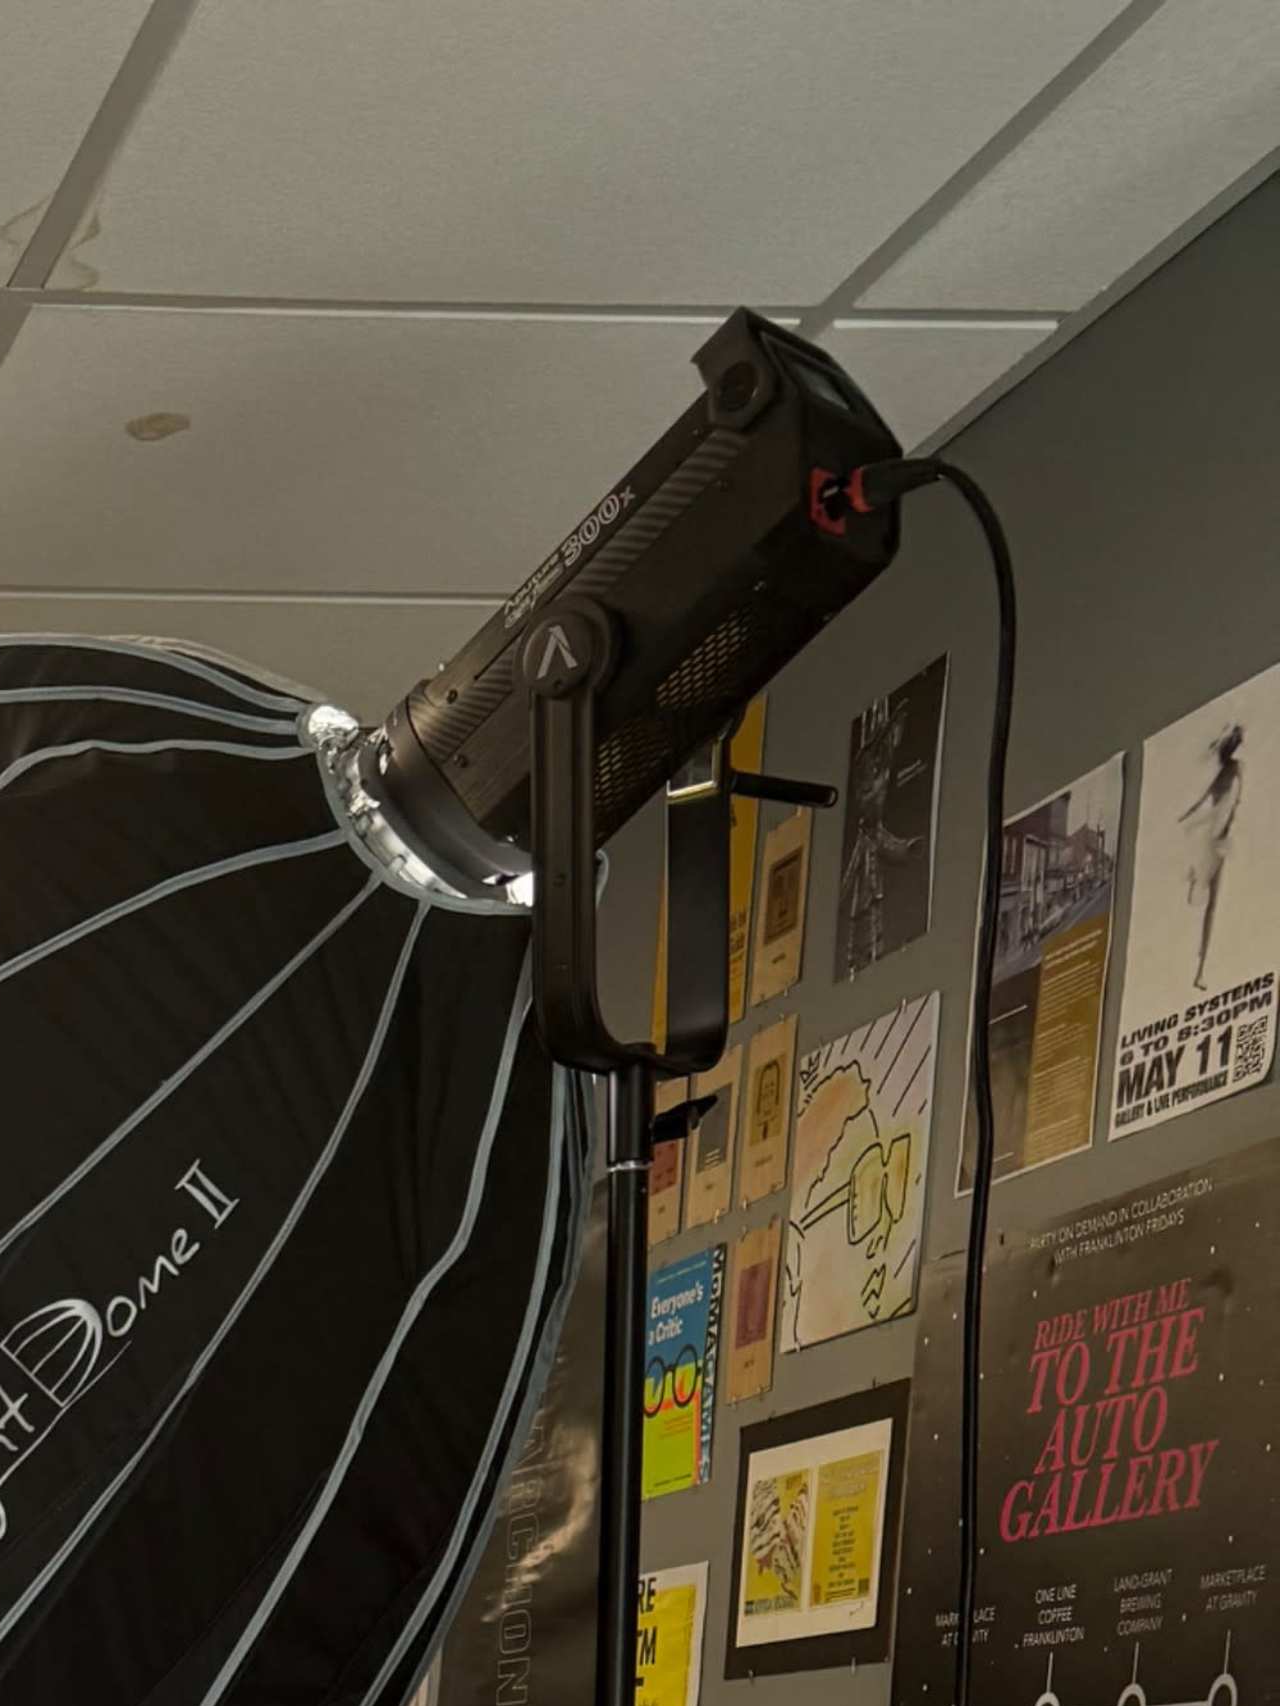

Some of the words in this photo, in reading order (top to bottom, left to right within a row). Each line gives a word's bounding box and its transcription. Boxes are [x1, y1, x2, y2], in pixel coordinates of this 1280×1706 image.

[1121, 1014, 1178, 1048] LIVING
[1184, 971, 1275, 1023] SYSTEMS
[1140, 1035, 1169, 1057] TO
[1177, 991, 1273, 1042] 8:30PM
[1117, 1045, 1186, 1109] MAY
[1196, 1025, 1233, 1076] 11
[1059, 1225, 1074, 1243] ON
[1076, 1211, 1118, 1239] DEMAND
[1130, 1176, 1214, 1219] COLLABORATION
[650, 1279, 705, 1320] Everyone's
[655, 1316, 684, 1344] Critic
[1034, 1309, 1088, 1351] RIDE
[1092, 1289, 1152, 1337] WITH
[1155, 1277, 1192, 1316] ME
[1026, 1341, 1091, 1415] TO
[1104, 1306, 1207, 1397] THE
[1033, 1384, 1168, 1476] AUTO
[999, 1439, 1221, 1543] GALLERY
[1035, 1586, 1056, 1605] ONE
[1199, 1562, 1269, 1591] MARKETPLACE
[1022, 1626, 1086, 1649] FRANKLINTON
[1037, 1605, 1074, 1626] COFFEE
[1115, 1615, 1165, 1637] COMPANY
